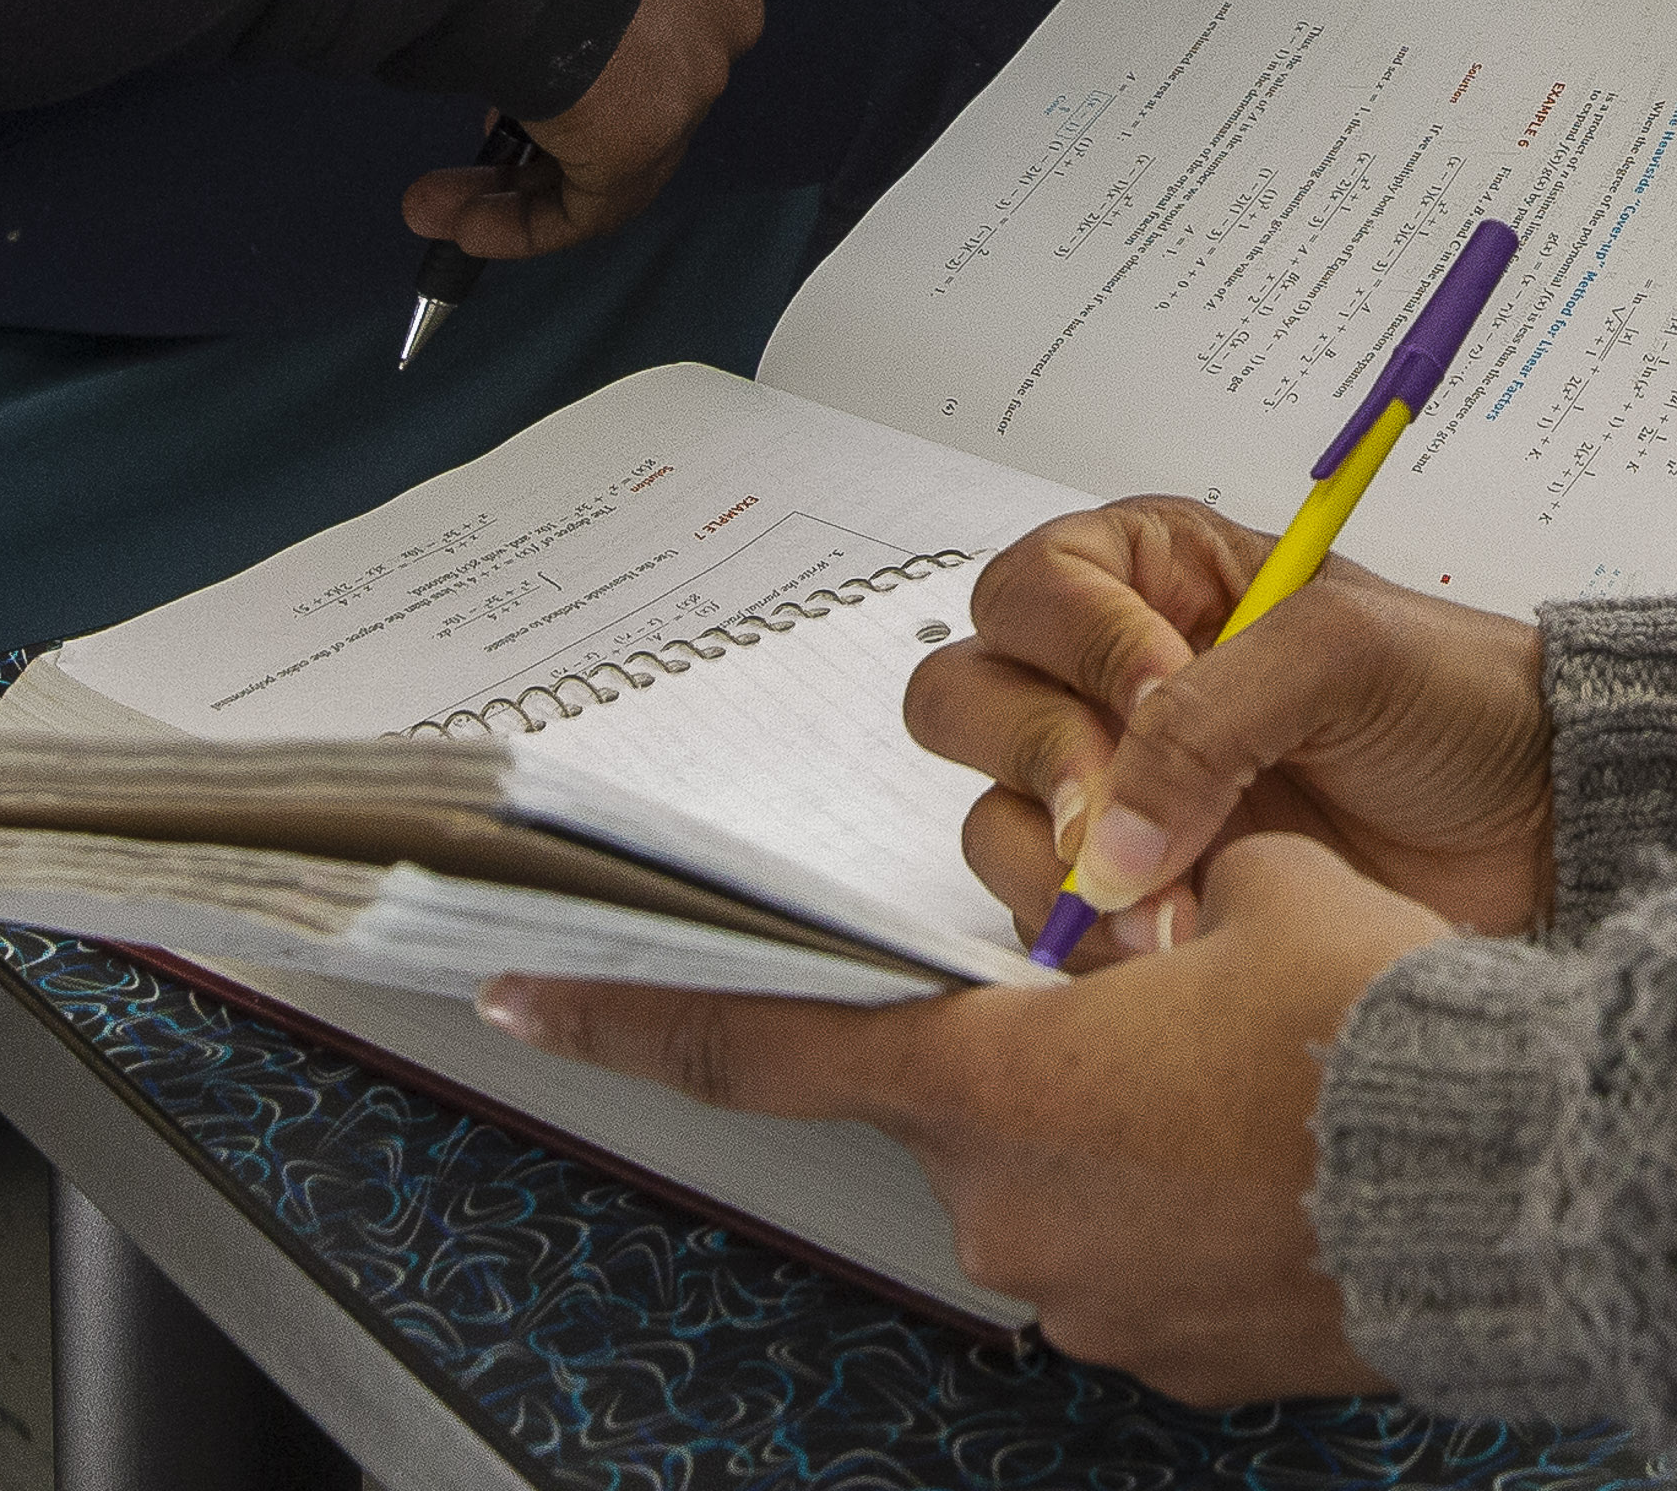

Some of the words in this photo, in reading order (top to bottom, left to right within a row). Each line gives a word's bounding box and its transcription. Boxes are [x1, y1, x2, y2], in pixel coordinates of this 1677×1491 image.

[1212, 0, 1233, 22] and
[1179, 20, 1219, 67] evaluated
[1294, 25, 1326, 52] Thus,
[1265, 60, 1282, 72] in
[1284, 53, 1303, 71] the
[1391, 45, 1411, 67] and
[1167, 61, 1186, 82] the
[1253, 71, 1272, 89] the
[1380, 65, 1397, 82] set
[1152, 80, 1172, 100] rest
[1263, 72, 1290, 99] value
[1374, 80, 1386, 91] x
[1448, 61, 1483, 105] Solution
[1143, 98, 1158, 111] at
[1588, 89, 1603, 102] to
[1604, 91, 1620, 103] is
[1137, 106, 1149, 119] x
[1246, 111, 1262, 123] A
[1254, 98, 1269, 116] of
[1353, 106, 1372, 117] 1,
[1522, 81, 1567, 138] EXAMPLE
[1598, 103, 1610, 112] a
[1640, 99, 1667, 135] When
[1208, 88, 1260, 149] denominator
[1238, 122, 1254, 133] is
[1343, 117, 1362, 136] the
[1564, 102, 1594, 143] expand
[1116, 130, 1133, 142] 1:
[1428, 123, 1445, 138] If
[1573, 112, 1605, 156] product
[1224, 133, 1244, 151] the
[1417, 135, 1435, 151] we
[1516, 138, 1531, 149] 6
[1629, 135, 1647, 155] the
[1185, 155, 1205, 175] the
[1198, 147, 1213, 163] of
[1309, 134, 1349, 180] resulting
[1565, 155, 1579, 173] of
[1633, 130, 1676, 195] Heaviside
[1195, 150, 1230, 188] number
[1386, 150, 1423, 195] multiply
[1487, 165, 1513, 192] Find
[1559, 169, 1570, 180] n
[1608, 155, 1637, 194] degree
[1154, 173, 1190, 212] original
[1181, 187, 1200, 202] we
[1278, 174, 1317, 220] equation
[1477, 190, 1493, 204] A,
[1522, 192, 1543, 208] by
[1533, 180, 1566, 221] distinct
[1599, 194, 1613, 211] of
[1369, 194, 1397, 218] both
[1468, 204, 1486, 218] B,
[1123, 210, 1161, 247] fraction
[1156, 202, 1186, 236] would
[1587, 208, 1607, 228] the
[1258, 218, 1284, 247] gives
[1350, 217, 1375, 245] sides
[1455, 218, 1475, 240] and
[1136, 230, 1164, 255] have
[1244, 244, 1265, 262] the
[1340, 243, 1356, 260] of
[1448, 239, 1462, 253] C
[1440, 250, 1457, 263] in
[1549, 226, 1594, 289] polynomial
[1100, 253, 1141, 295] obtained
[1222, 261, 1251, 288] value
[1306, 256, 1349, 300] Equation
[1426, 257, 1447, 281] the
[1092, 292, 1105, 306] if
[1202, 297, 1217, 312] A:
[1212, 287, 1228, 303] of
[1401, 278, 1432, 314] partial
[1532, 286, 1556, 312] f(x)
[1559, 270, 1599, 318] Method
[1078, 303, 1097, 318] we
[1291, 299, 1313, 316] (3)
[1525, 311, 1543, 324] is
[1061, 317, 1087, 338] had
[1281, 315, 1302, 330] by
[1371, 313, 1409, 352] fraction
[1546, 318, 1568, 340] for
[1511, 323, 1535, 345] less
[1029, 336, 1066, 378] covered
[1493, 344, 1518, 369] than
[1518, 339, 1554, 379] Linear
[1240, 364, 1256, 377] to
[1331, 351, 1377, 399] expansion
[1480, 368, 1501, 387] the
[1016, 377, 1035, 397] the
[1225, 374, 1245, 394] get
[1454, 385, 1487, 421] degree
[1484, 379, 1525, 422] Factors
[995, 397, 1023, 437] factor
[1444, 419, 1460, 436] of
[1425, 429, 1449, 454] g(x)
[1410, 452, 1432, 475] and
[1202, 486, 1223, 511] (3)
[701, 494, 761, 535] EXAMPLE
[693, 528, 707, 541] 7
